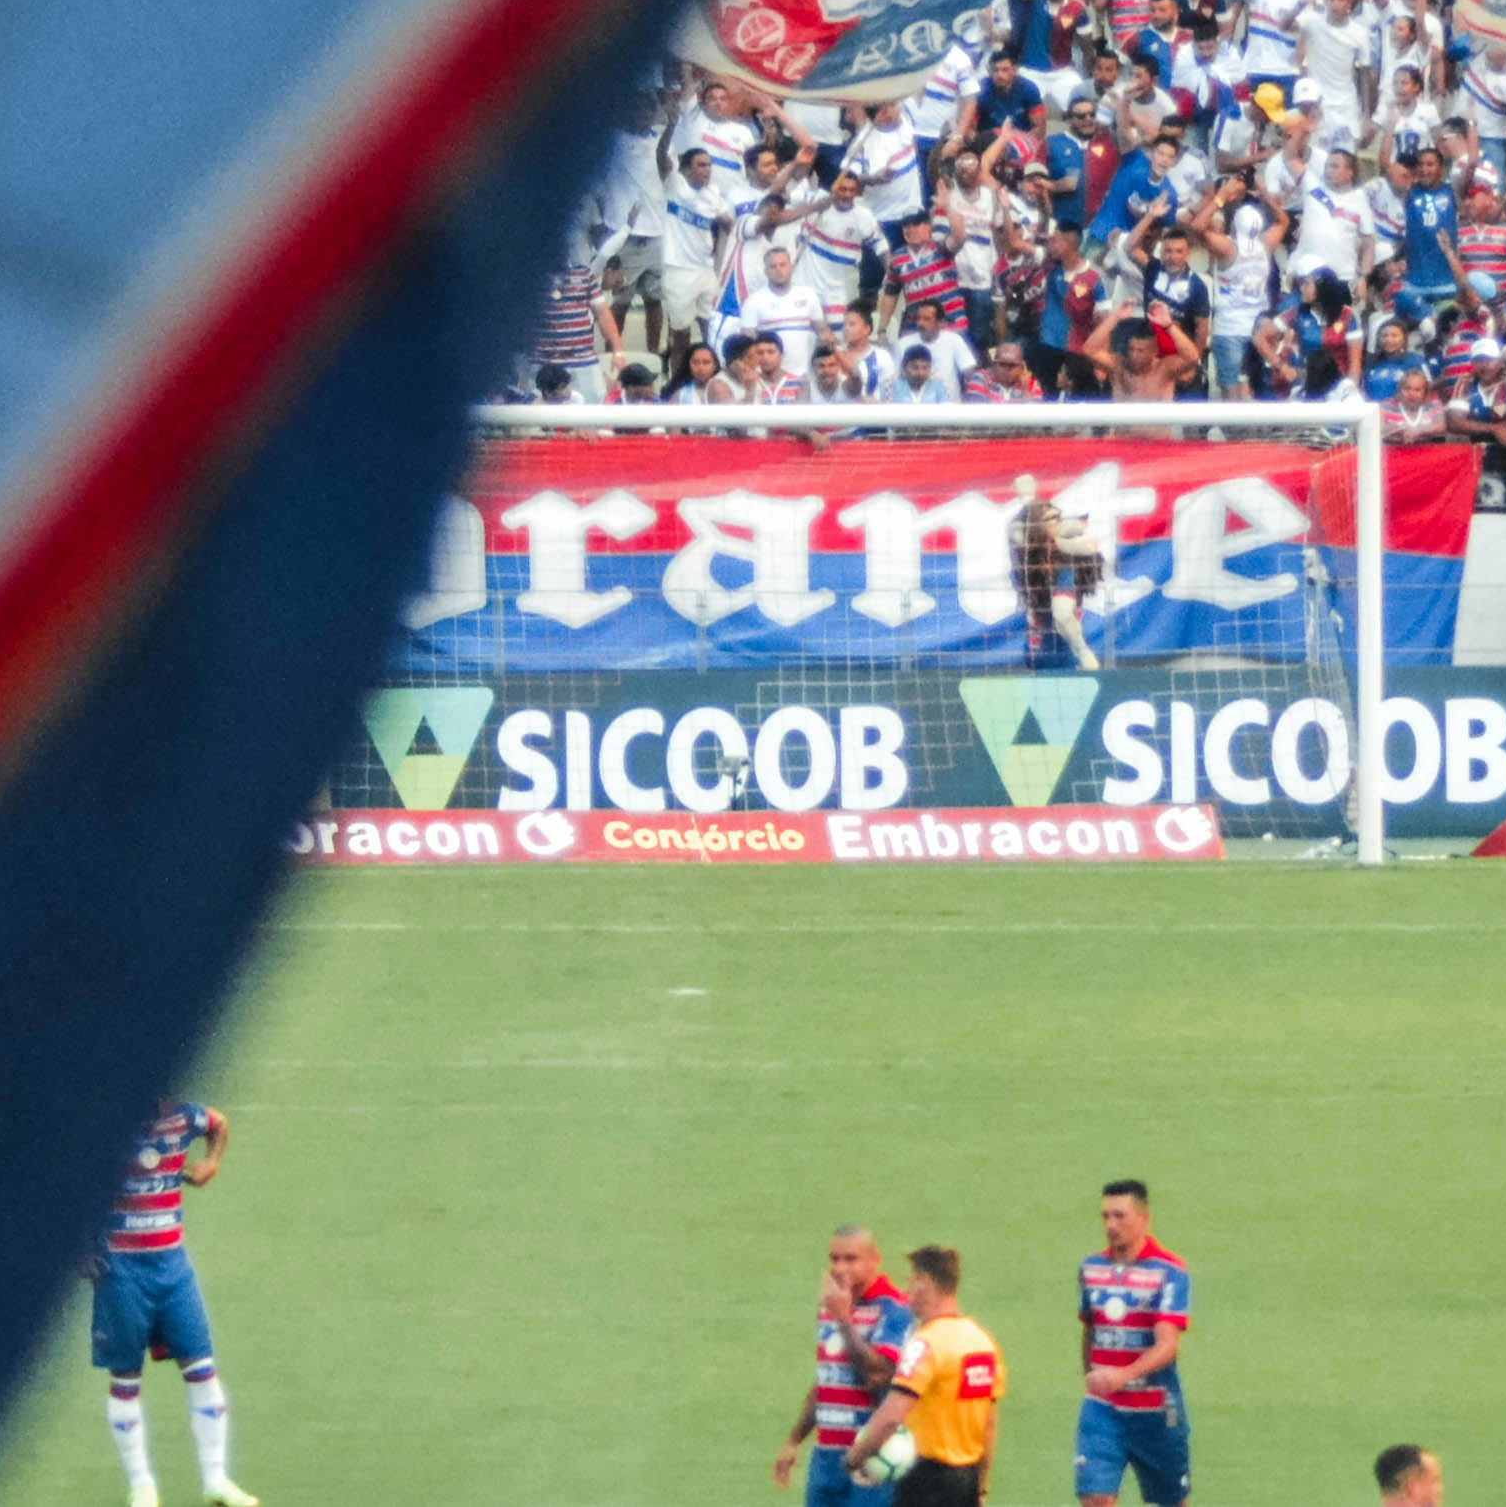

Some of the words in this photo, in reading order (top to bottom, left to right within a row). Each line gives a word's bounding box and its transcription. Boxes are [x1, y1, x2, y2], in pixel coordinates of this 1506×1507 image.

[496, 706, 908, 813] SICOOB
[603, 820, 805, 852] Consórcio
[826, 813, 1140, 859] Embracon
